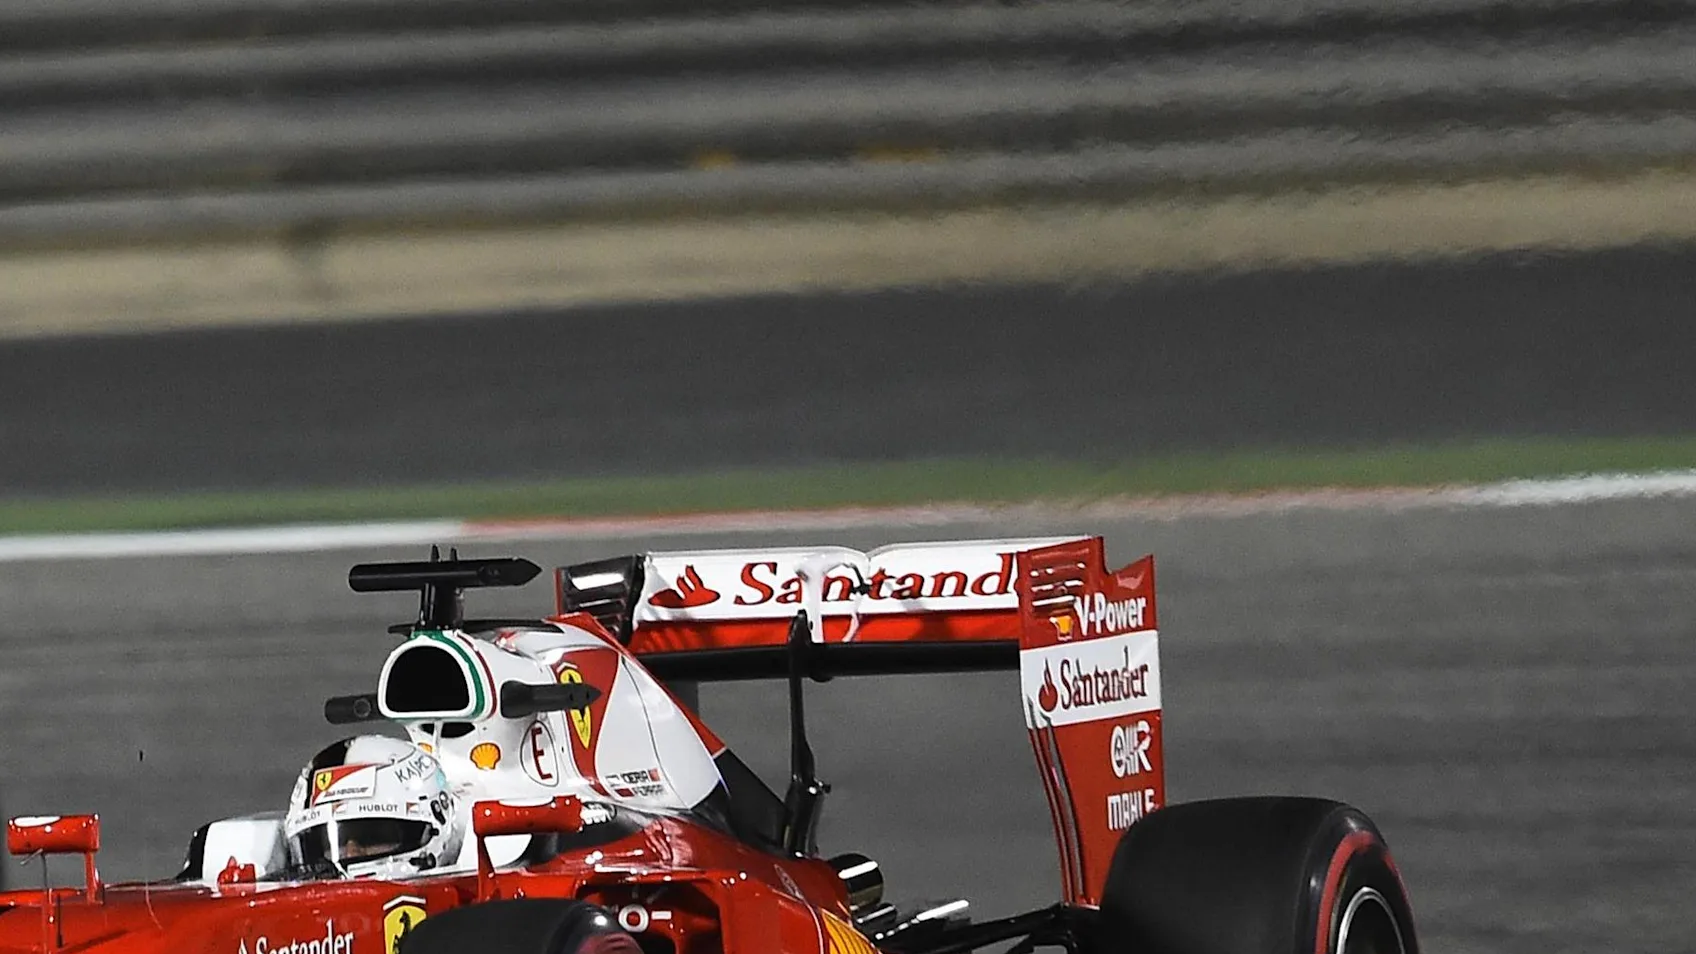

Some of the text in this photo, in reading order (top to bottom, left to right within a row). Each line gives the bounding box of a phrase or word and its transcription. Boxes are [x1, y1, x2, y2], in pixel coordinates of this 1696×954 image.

[734, 552, 1021, 607] Santand
[1074, 592, 1147, 637] V-Power
[1060, 645, 1149, 711] Santander
[530, 726, 555, 780] E
[358, 803, 399, 813] HUBLOT
